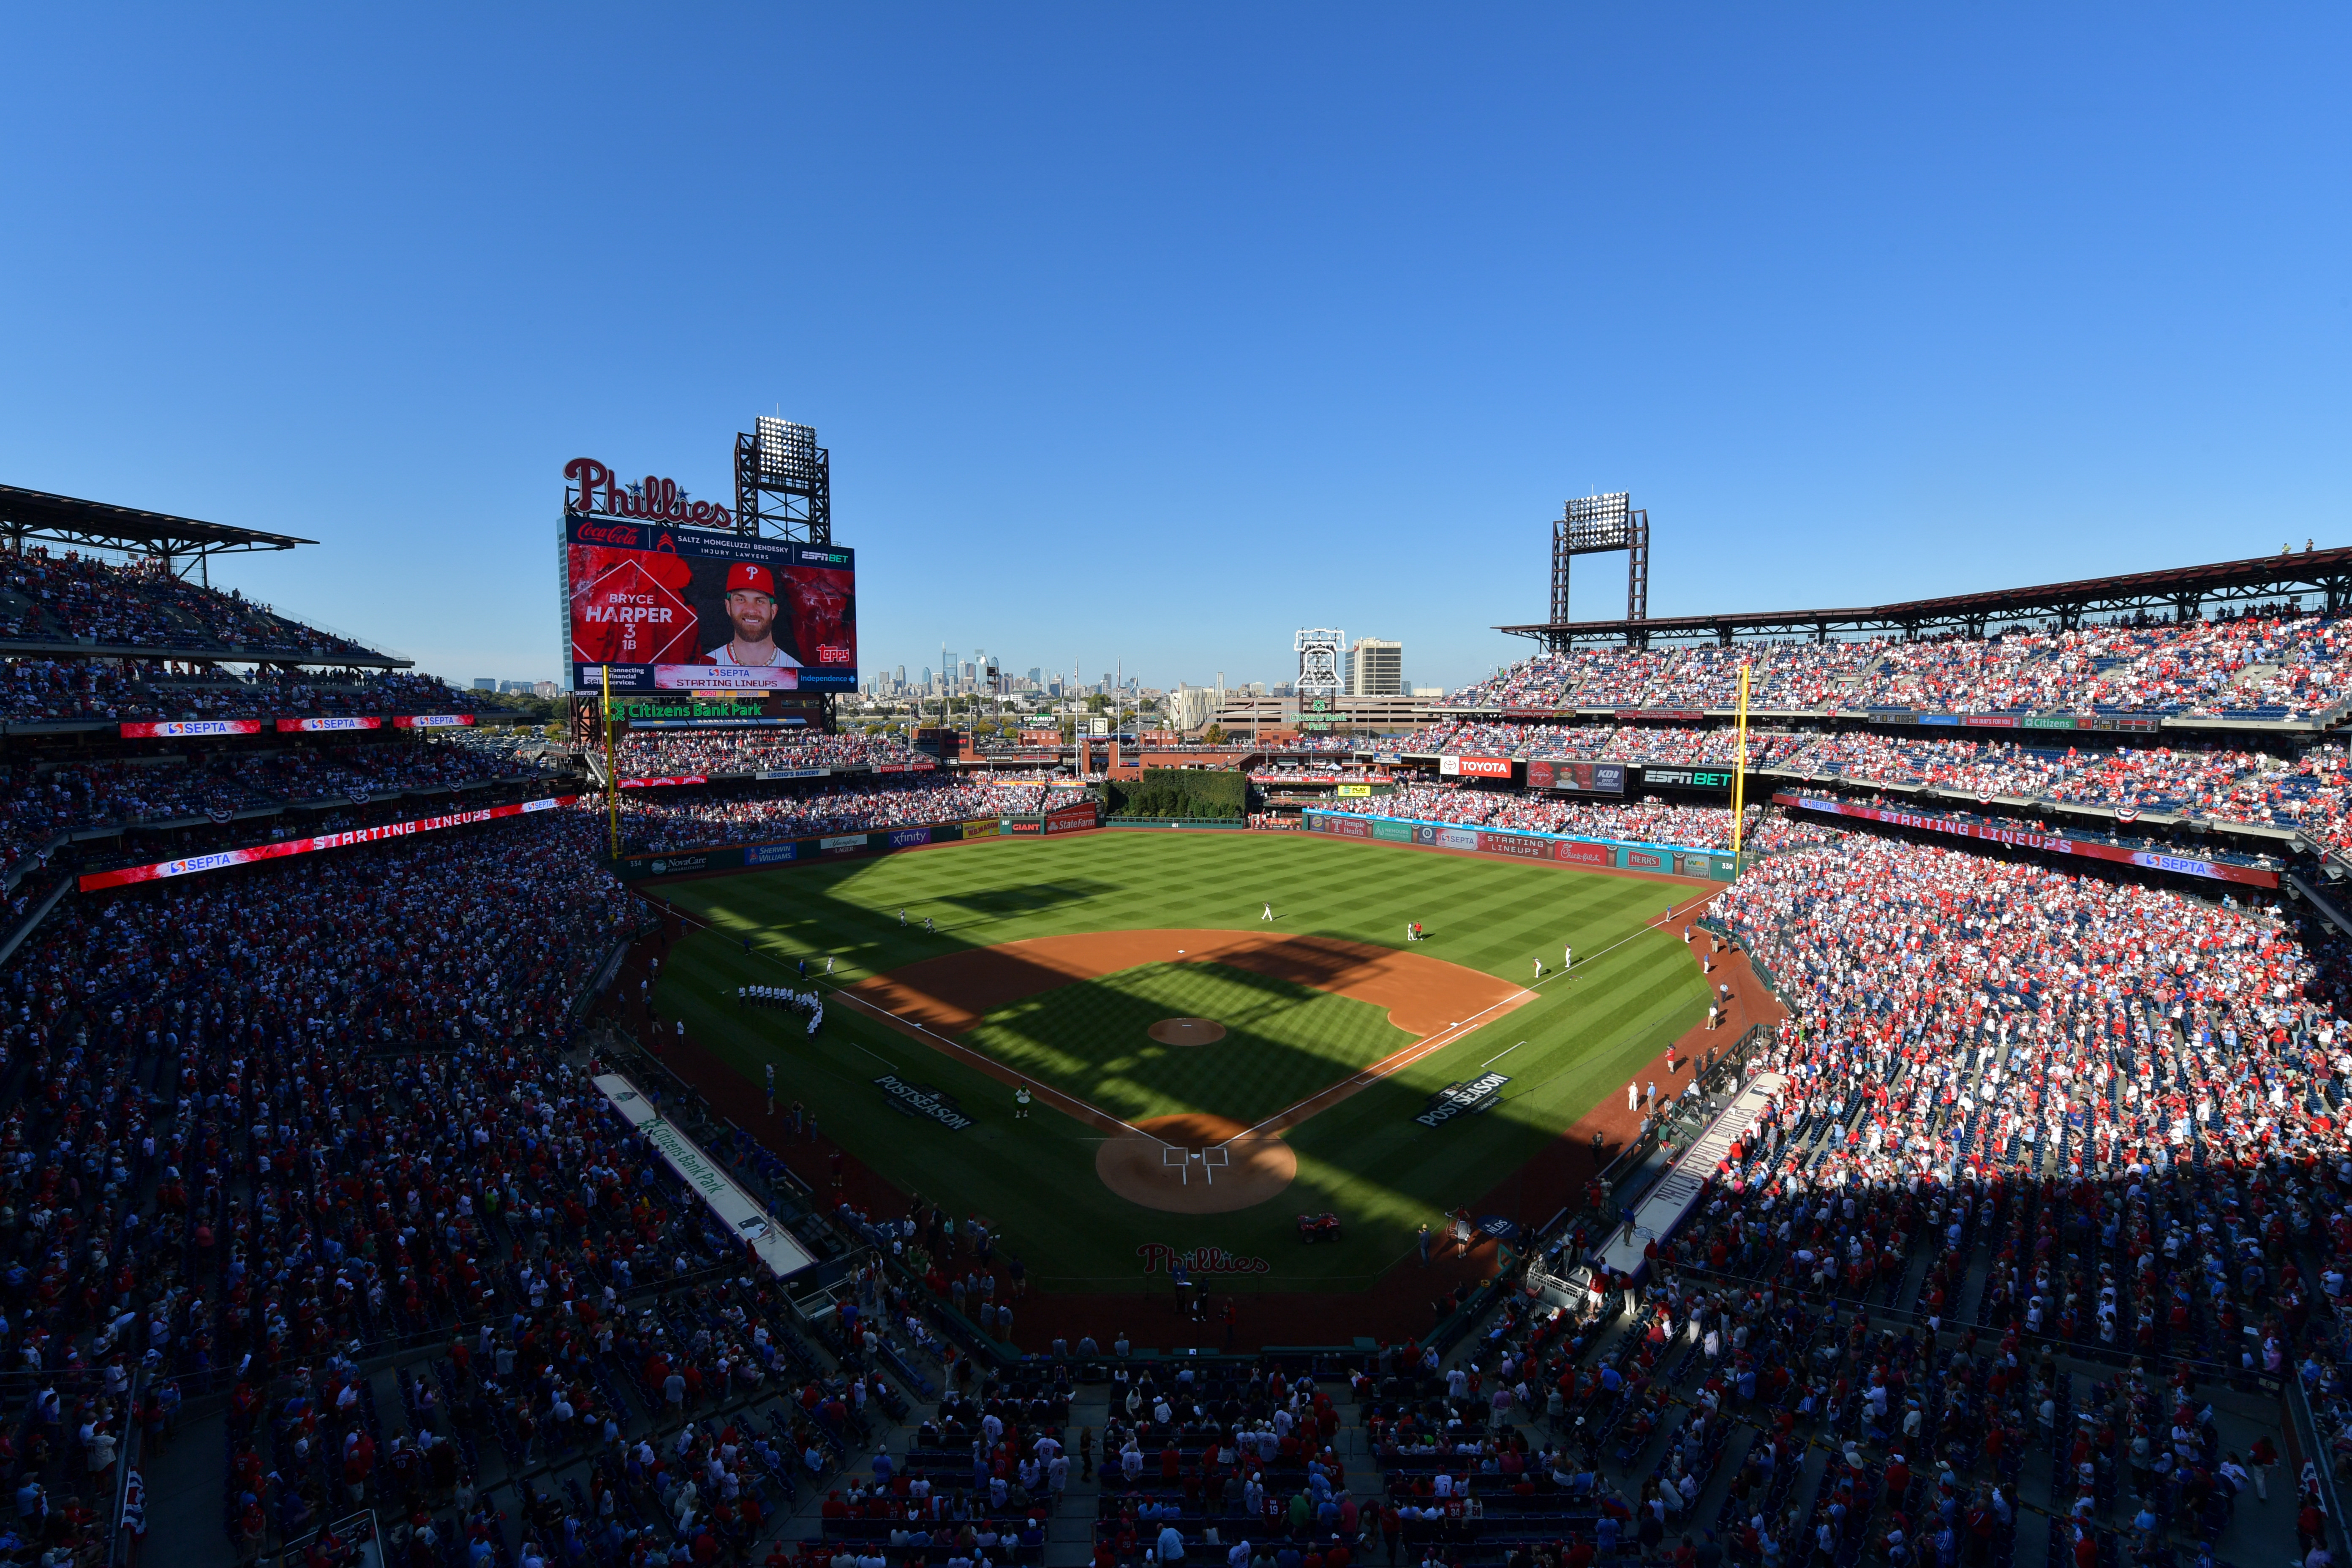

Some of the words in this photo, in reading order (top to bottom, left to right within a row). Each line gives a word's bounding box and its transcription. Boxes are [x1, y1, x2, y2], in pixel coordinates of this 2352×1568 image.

[563, 457, 732, 528] Phillies
[678, 535, 700, 544] SALTZ
[704, 539, 750, 549] MONGELUZZI
[754, 544, 789, 553] BENDESKY
[735, 552, 769, 560] LAWYERS
[746, 566, 758, 580] P
[609, 593, 654, 604] BRYCE
[585, 606, 672, 623] HARPER
[624, 624, 636, 639] 3
[622, 640, 637, 650] 1B
[720, 669, 750, 677] SEPTA
[677, 679, 732, 687] STARTING
[801, 675, 848, 683] Independence
[628, 704, 690, 717] Citizens
[693, 703, 730, 716] Bank
[732, 703, 762, 716] Park
[429, 716, 454, 725] SEPTA
[1290, 713, 1324, 721] Citizens
[1326, 712, 1347, 721] Bank
[185, 722, 227, 734] SEPTA
[324, 719, 355, 729] SEPTA
[1309, 722, 1328, 731] Park
[2034, 718, 2070, 728] Citizens
[1461, 761, 1508, 773] TOYOTA
[1597, 770, 1620, 779] KDI
[620, 780, 629, 788] JIM
[630, 779, 644, 787] BEAM
[662, 777, 675, 785] BEAM
[1811, 801, 1832, 811] SEPTA
[313, 821, 416, 850] STARTING
[425, 808, 491, 831] LINEUPS
[535, 799, 553, 809] SEPTA
[1343, 819, 1365, 828] Temple
[1343, 827, 1364, 836] Health
[1880, 811, 1969, 836] STARTING
[1979, 826, 2072, 853] LINEUPS
[830, 837, 859, 848] Yuengling
[893, 831, 926, 845] xfinity
[1451, 836, 1474, 844] SEPTA
[1487, 835, 1544, 847] STARTING
[759, 845, 791, 855] SHERWIN
[1492, 845, 1538, 855] LINEUPS
[188, 854, 231, 871] SEPTA
[667, 856, 707, 868] NovaCare
[1631, 854, 1656, 865] HERR'S
[668, 864, 705, 873] REHABILITATION
[2162, 857, 2206, 875] SEPTA
[873, 1075, 972, 1130] POSTSEASON
[1416, 1073, 1509, 1127] POSTSEASON
[1712, 1105, 1758, 1138] PHILLIES
[652, 1128, 686, 1157] Citizens
[677, 1154, 708, 1176] Bank
[696, 1173, 726, 1195] Park
[1654, 1140, 1730, 1206] PHILADELPHIA
[1136, 1242, 1271, 1274] Phillies
[1443, 1484, 1448, 1492] 7
[1269, 1506, 1278, 1515] 19
[1451, 1508, 1460, 1516] 34
